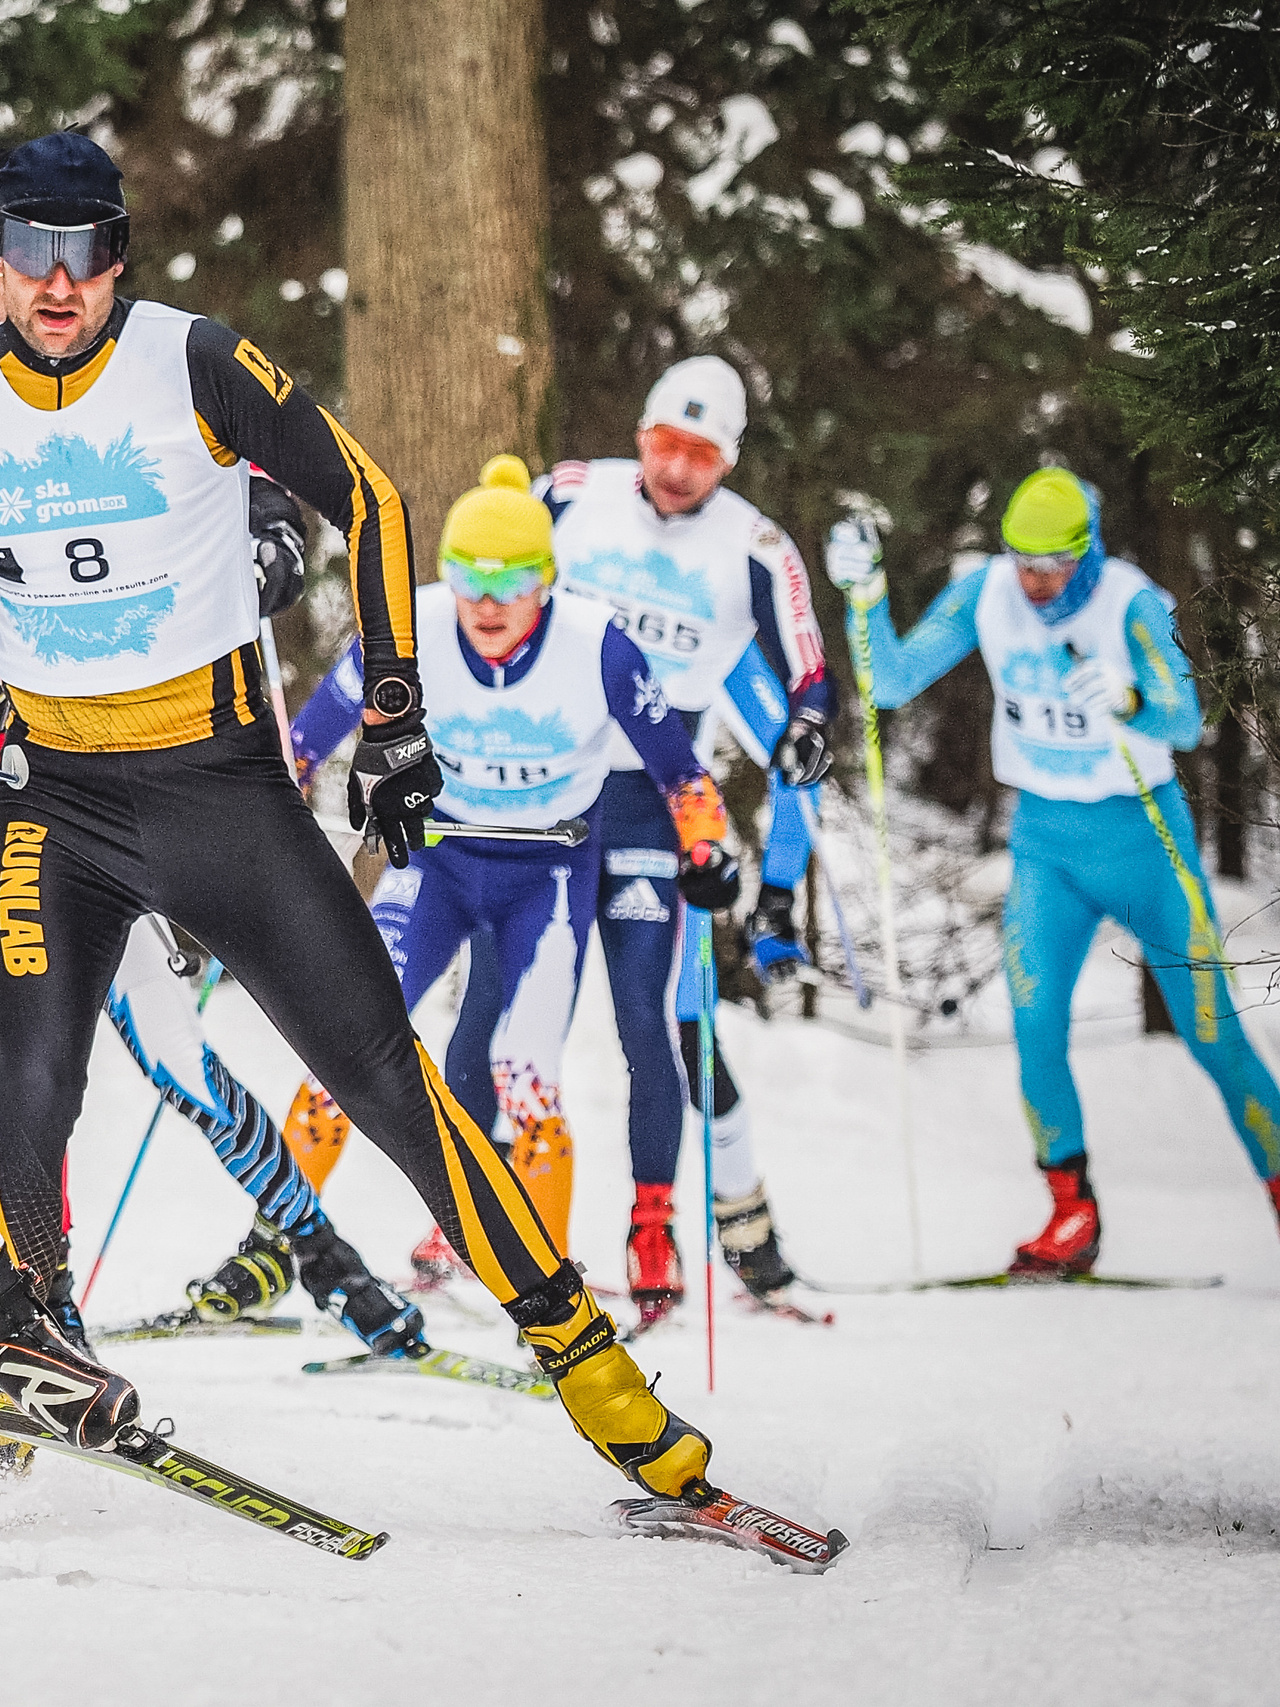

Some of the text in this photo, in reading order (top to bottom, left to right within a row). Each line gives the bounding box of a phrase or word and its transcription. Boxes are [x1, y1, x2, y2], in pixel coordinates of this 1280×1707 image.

[35, 479, 71, 499] ski
[36, 498, 99, 523] grom
[65, 538, 110, 583] 8
[548, 1327, 608, 1369] SALOMON
[733, 1509, 829, 1559] MADSHUS
